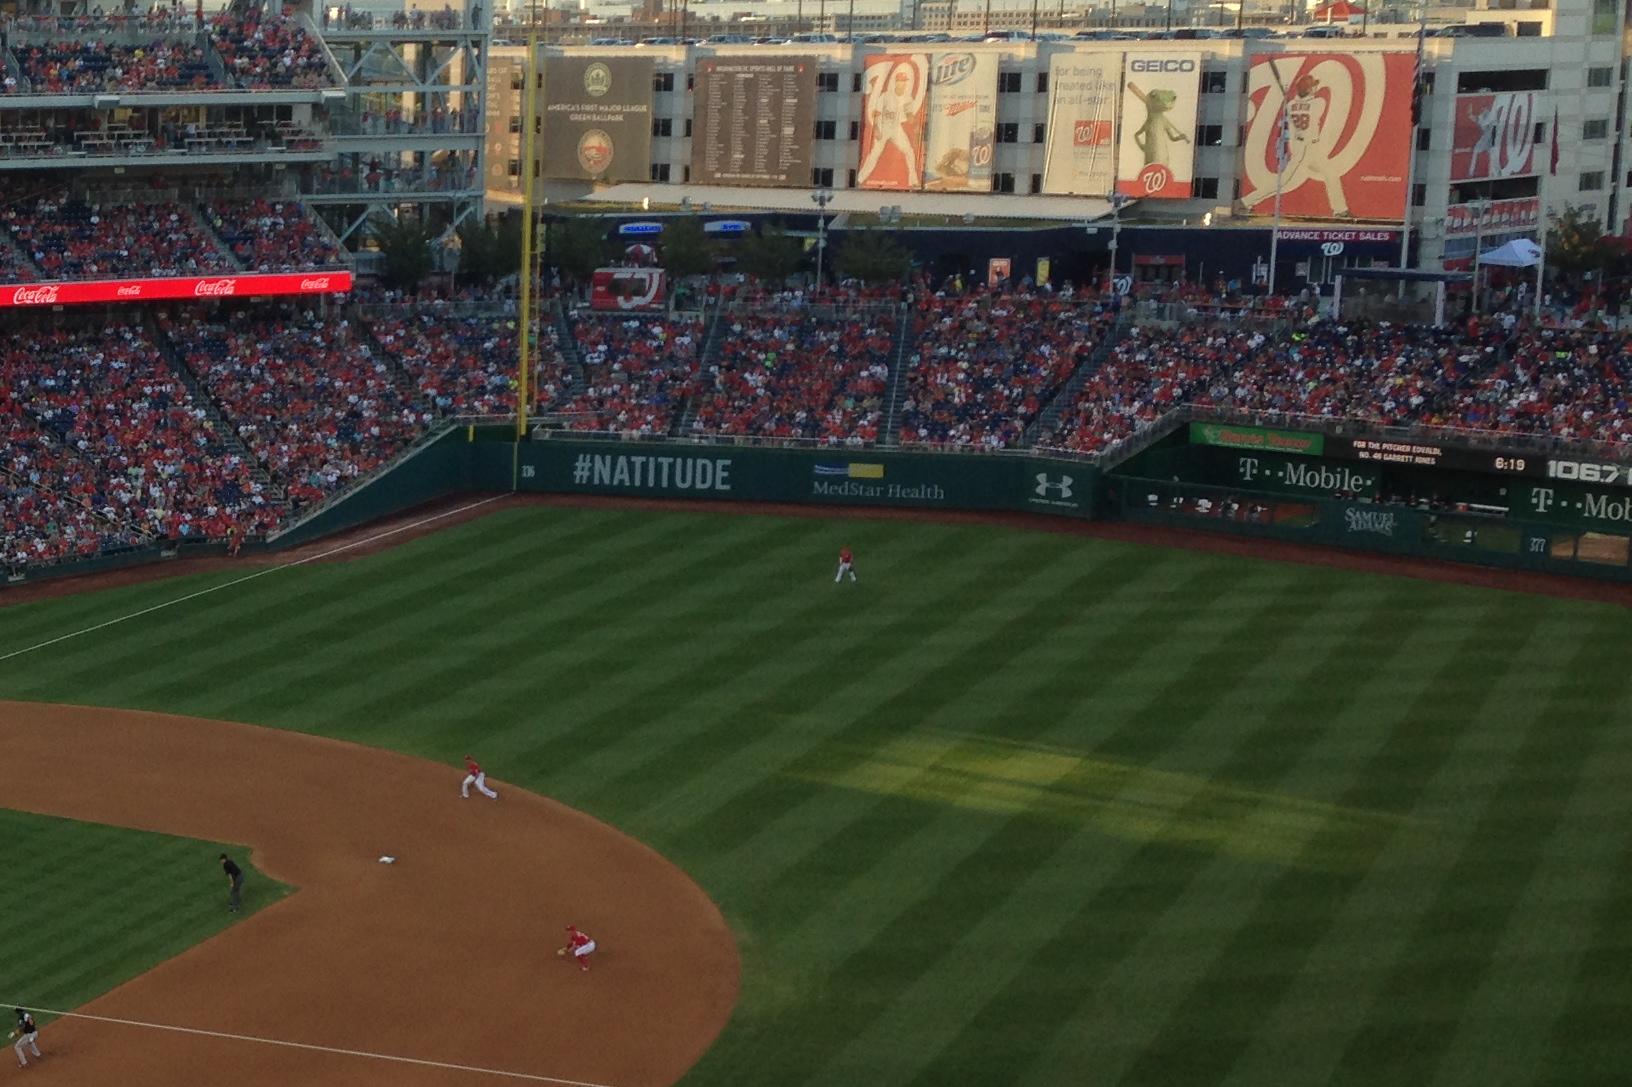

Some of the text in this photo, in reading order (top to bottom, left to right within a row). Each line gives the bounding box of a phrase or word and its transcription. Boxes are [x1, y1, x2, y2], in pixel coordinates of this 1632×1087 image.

[1055, 66, 1103, 79] for being
[1131, 60, 1195, 73] GEICO
[1055, 80, 1092, 91] reated
[547, 103, 647, 112] AMERICA'S FIRST MAJOR LEAGUE
[1291, 113, 1309, 130] 28
[1277, 231, 1389, 240] ADVANCE TICKET SALES
[13, 285, 60, 305] Coca-Cola
[194, 279, 237, 296] Coca-Cola
[573, 453, 732, 490] #NATITUDE
[813, 481, 945, 500] MedStar Health
[1344, 506, 1395, 524] SAMUEL
